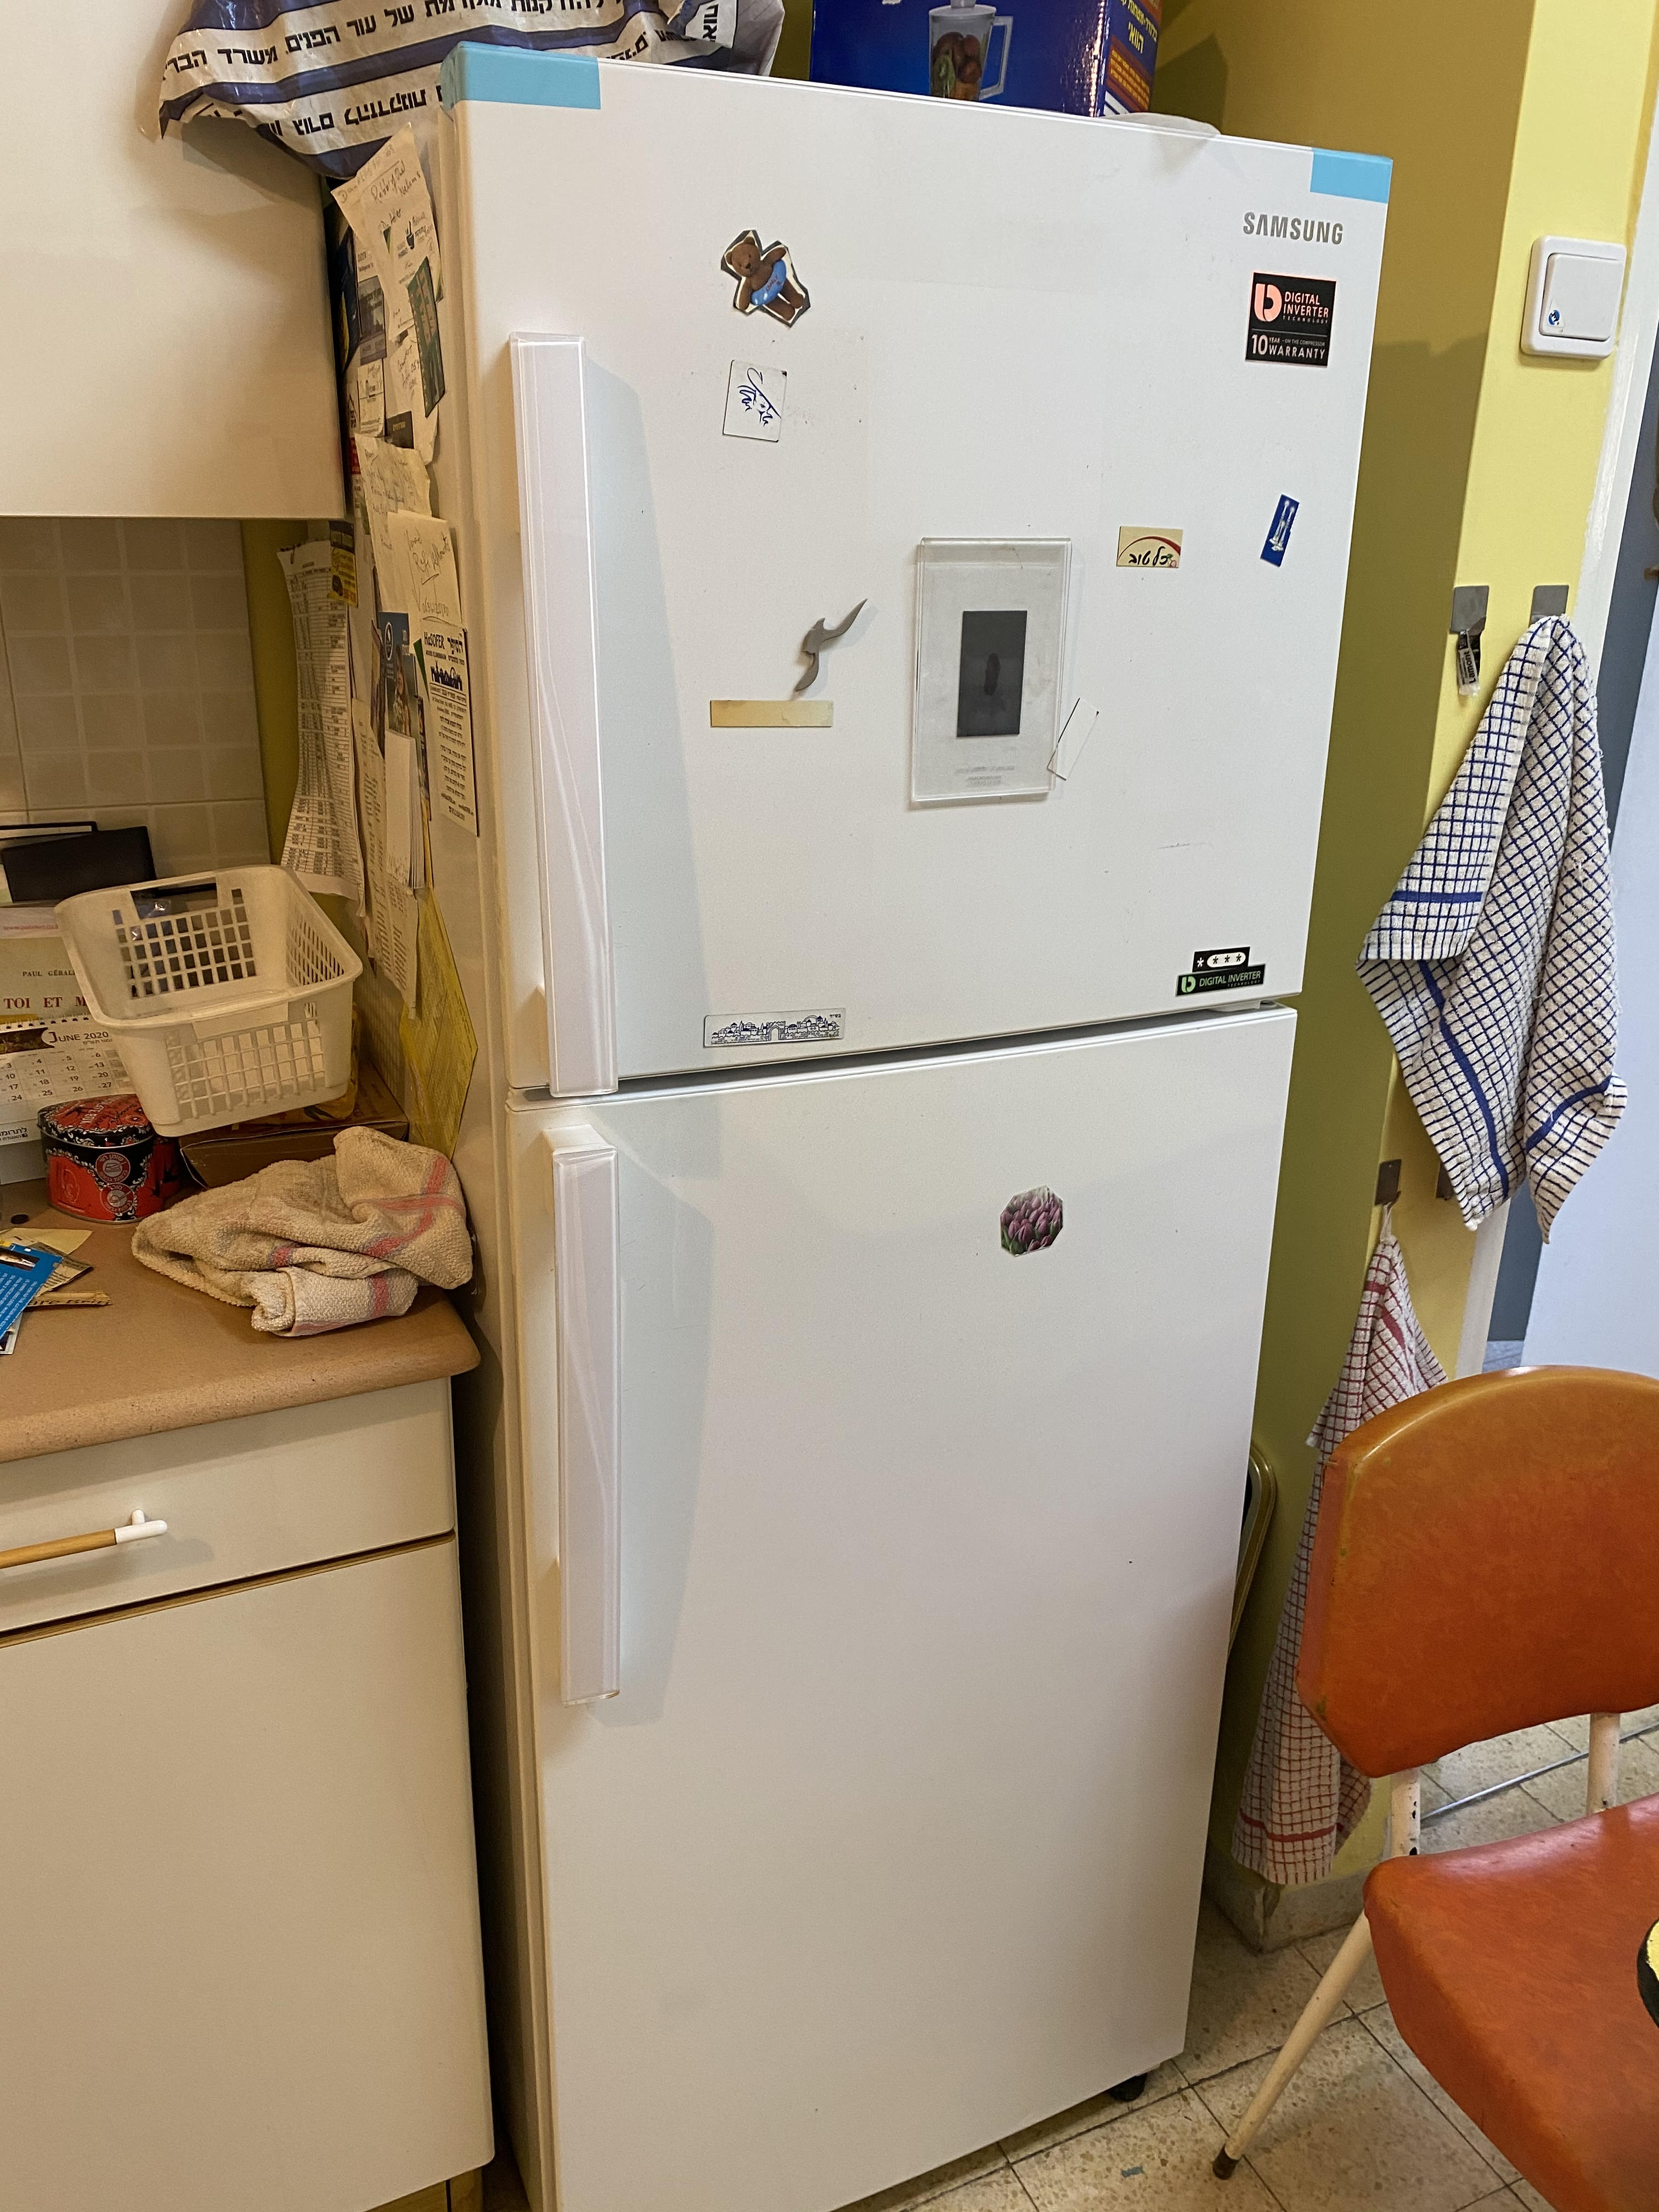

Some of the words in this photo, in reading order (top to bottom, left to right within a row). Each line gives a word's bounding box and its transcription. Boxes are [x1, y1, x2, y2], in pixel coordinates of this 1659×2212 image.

[383, 4, 415, 27] של
[346, 15, 377, 37] עור
[165, 49, 207, 73] הבר
[217, 46, 278, 65] משרד
[1243, 212, 1343, 245] SAMSUNG
[1284, 291, 1320, 305] DIGITAL
[1283, 303, 1329, 318] INVERTER
[1283, 315, 1328, 324] TECHNOLOGY
[1251, 334, 1268, 355] 10
[1269, 344, 1325, 359] WARRANTY
[1128, 550, 1151, 566] טוב
[1463, 650, 1476, 684] Lamont
[1199, 975, 1227, 987] DIGITAL
[1228, 970, 1261, 983] INVERTER
[3, 997, 31, 1009] TOI
[43, 996, 63, 1008] ET
[83, 1031, 109, 1040] 2020
[0, 1127, 27, 1136] לתרומ
